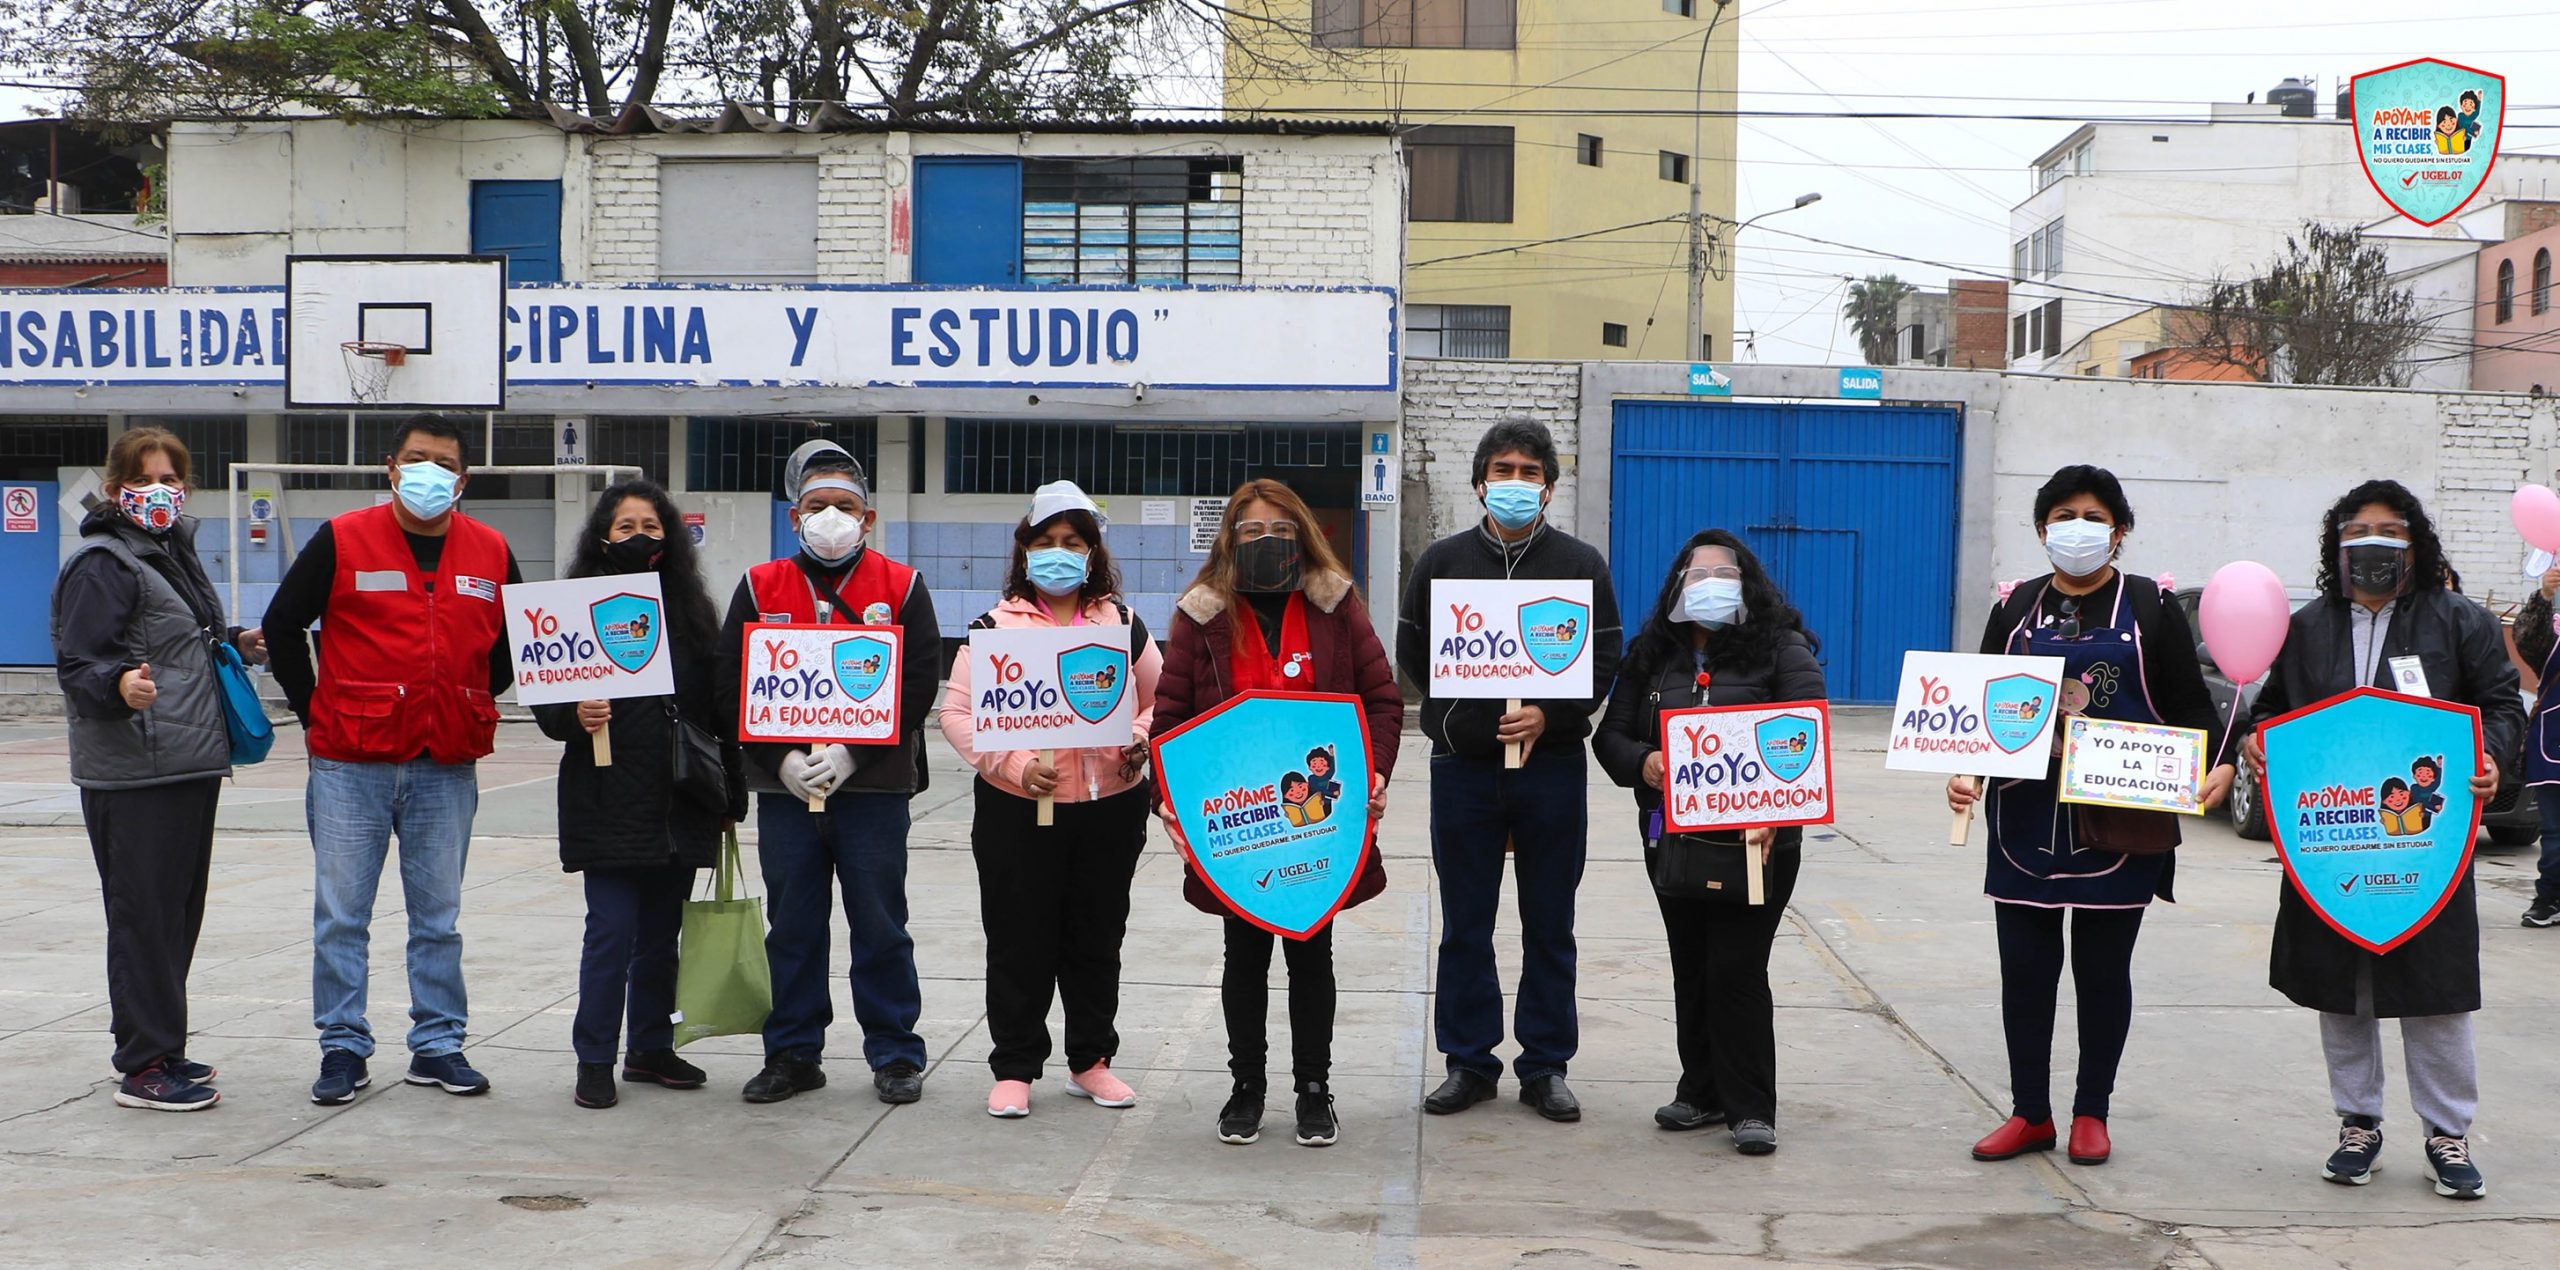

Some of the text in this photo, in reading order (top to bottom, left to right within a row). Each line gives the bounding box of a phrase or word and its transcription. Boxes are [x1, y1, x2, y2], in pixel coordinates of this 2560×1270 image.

[785, 307, 818, 367] Y
[1842, 377, 1879, 390] SALIDA
[557, 456, 585, 465] BAÑO
[1365, 492, 1394, 502] BAÑO
[519, 663, 614, 686] LA EDUCACIÓN
[1434, 662, 1534, 679] LA EDUCACIÓN
[749, 704, 891, 726] LA EDUCACIÓN
[976, 712, 1075, 732] LA EDUCACIÓN
[1893, 735, 1992, 753] LA EDUCACIÓN
[2094, 738, 2176, 756] YO APOYO
[2123, 760, 2142, 770] LA
[2084, 774, 2179, 793] EDUCACIÓN
[1202, 785, 1278, 817] APÓYAME
[1676, 784, 1823, 816] LA EDUCACIÓN
[2298, 784, 2376, 809] APÓYAME
[1208, 804, 1280, 833] A RECIBIR
[2300, 809, 2376, 826] A RECIBIR
[1209, 821, 1288, 849] MIS CLASES,
[1224, 846, 1251, 858] QUIERO
[1252, 837, 1290, 850] QUEDARME
[1291, 834, 1303, 842] SIN
[1304, 826, 1338, 840] ESTUDIAR
[2300, 826, 2380, 843] MIS CLASES,
[2312, 845, 2340, 853] QUIERO
[2341, 843, 2382, 851] QUEDARME
